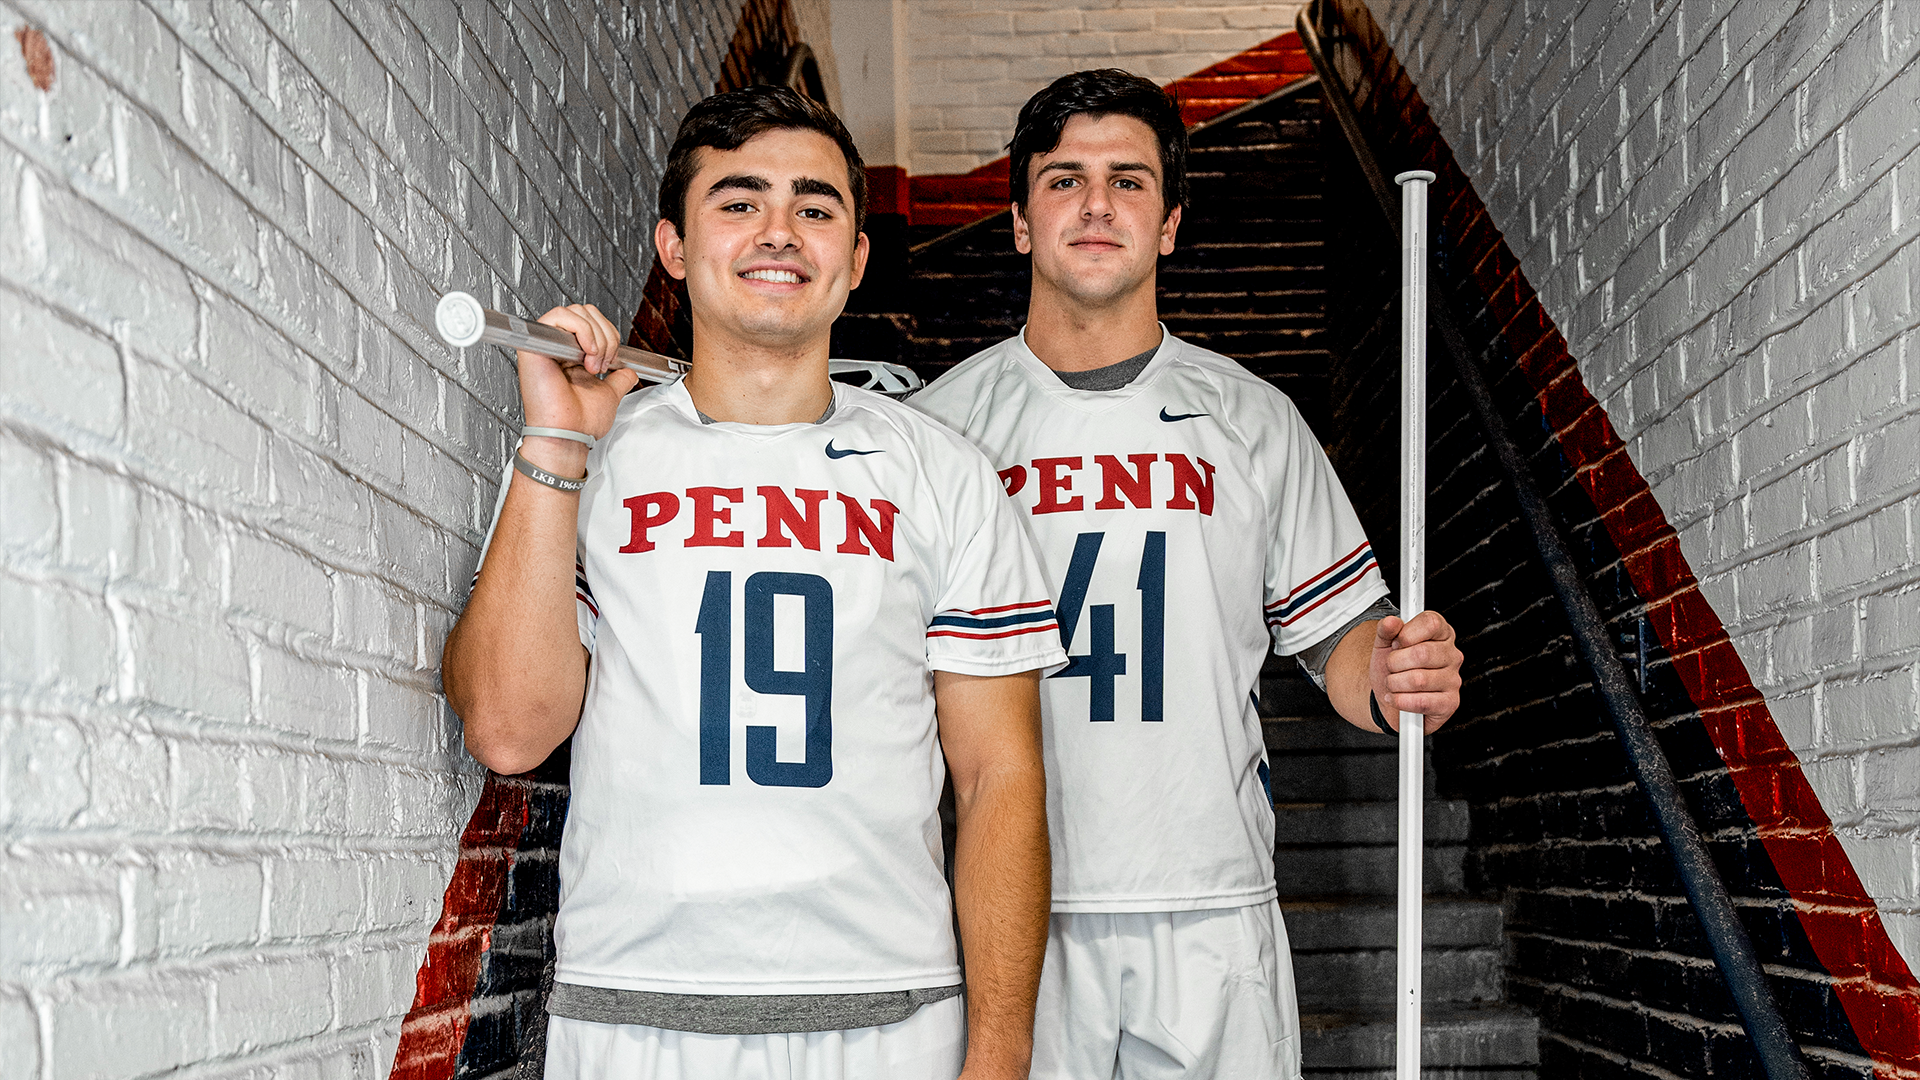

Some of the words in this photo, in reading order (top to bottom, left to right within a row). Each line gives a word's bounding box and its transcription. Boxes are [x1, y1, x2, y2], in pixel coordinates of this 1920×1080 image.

[531, 469, 556, 485] LKB
[620, 486, 900, 562] PENN
[694, 570, 835, 789] 19
[1045, 530, 1167, 723] 41
